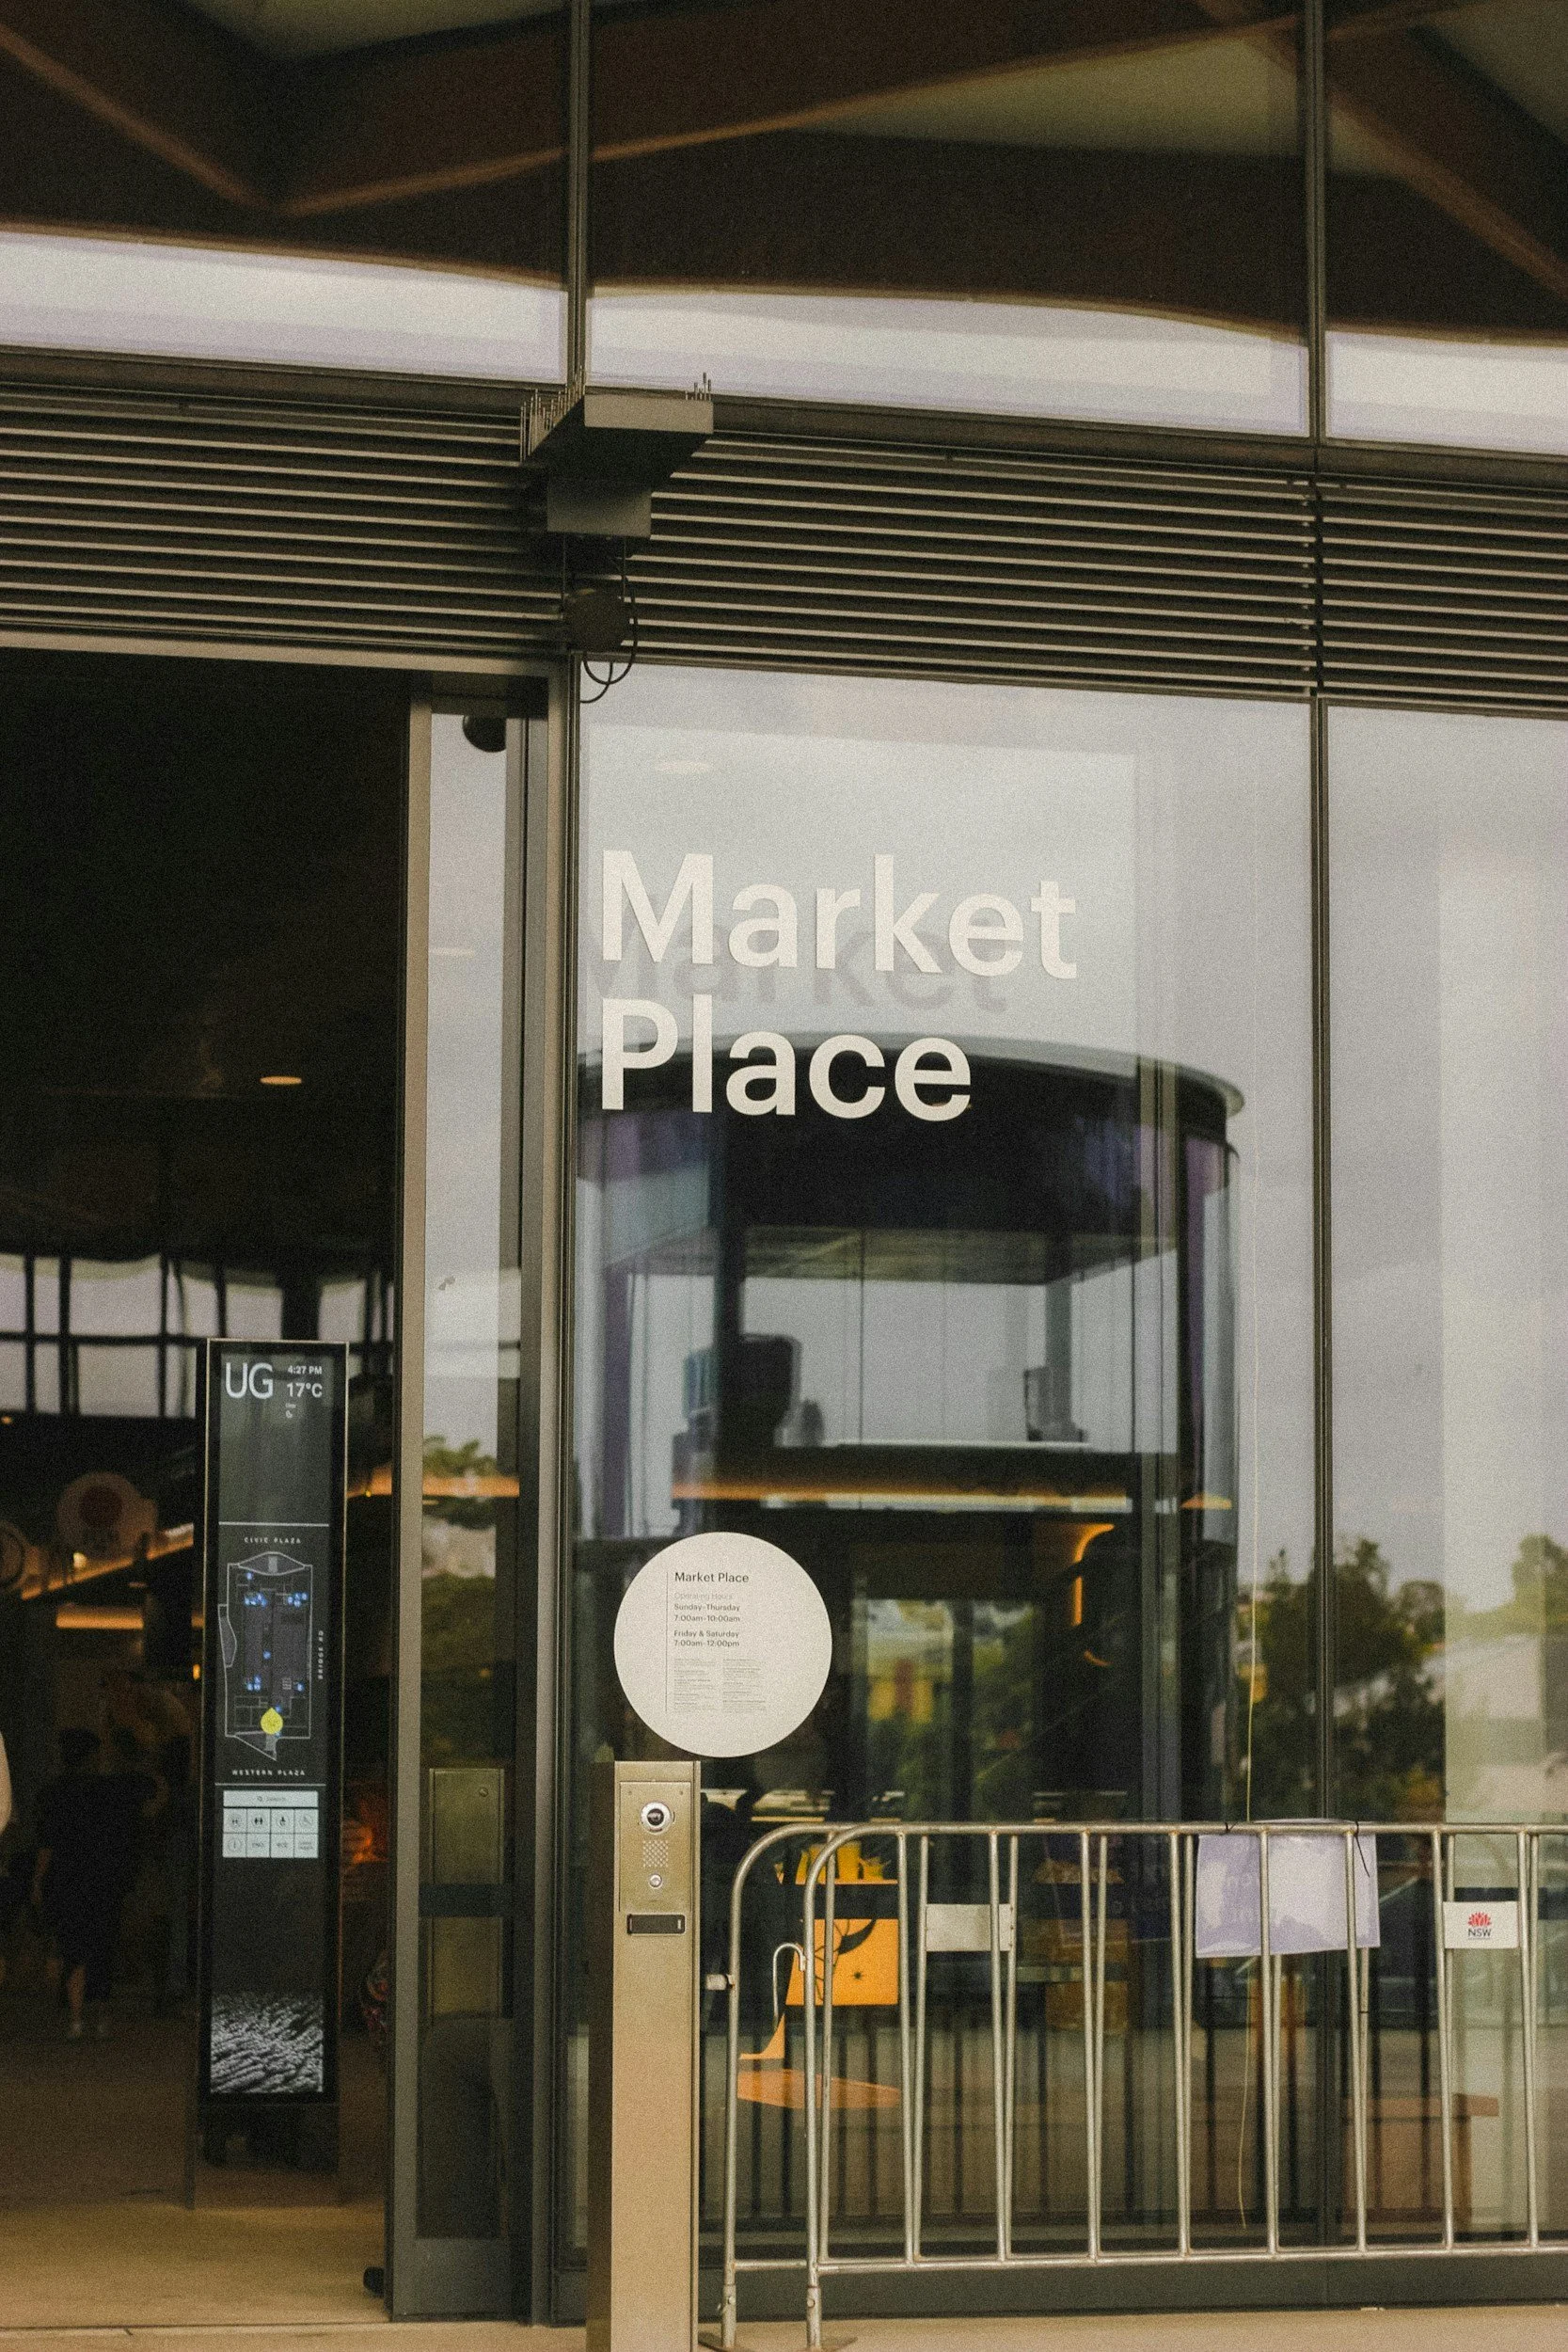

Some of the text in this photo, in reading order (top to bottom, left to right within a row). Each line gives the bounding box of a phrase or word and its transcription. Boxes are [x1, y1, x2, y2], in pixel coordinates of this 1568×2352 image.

[602, 850, 1078, 979] Market
[601, 993, 972, 1121] Place
[288, 1365, 323, 1375] 4:27 PM
[225, 1362, 274, 1400] UG
[287, 1382, 323, 1399] 17°C
[674, 1571, 750, 1582] Market Place
[673, 1629, 697, 1638] Friday
[705, 1629, 739, 1638] Saturday
[1467, 1928, 1492, 1937] NSW
